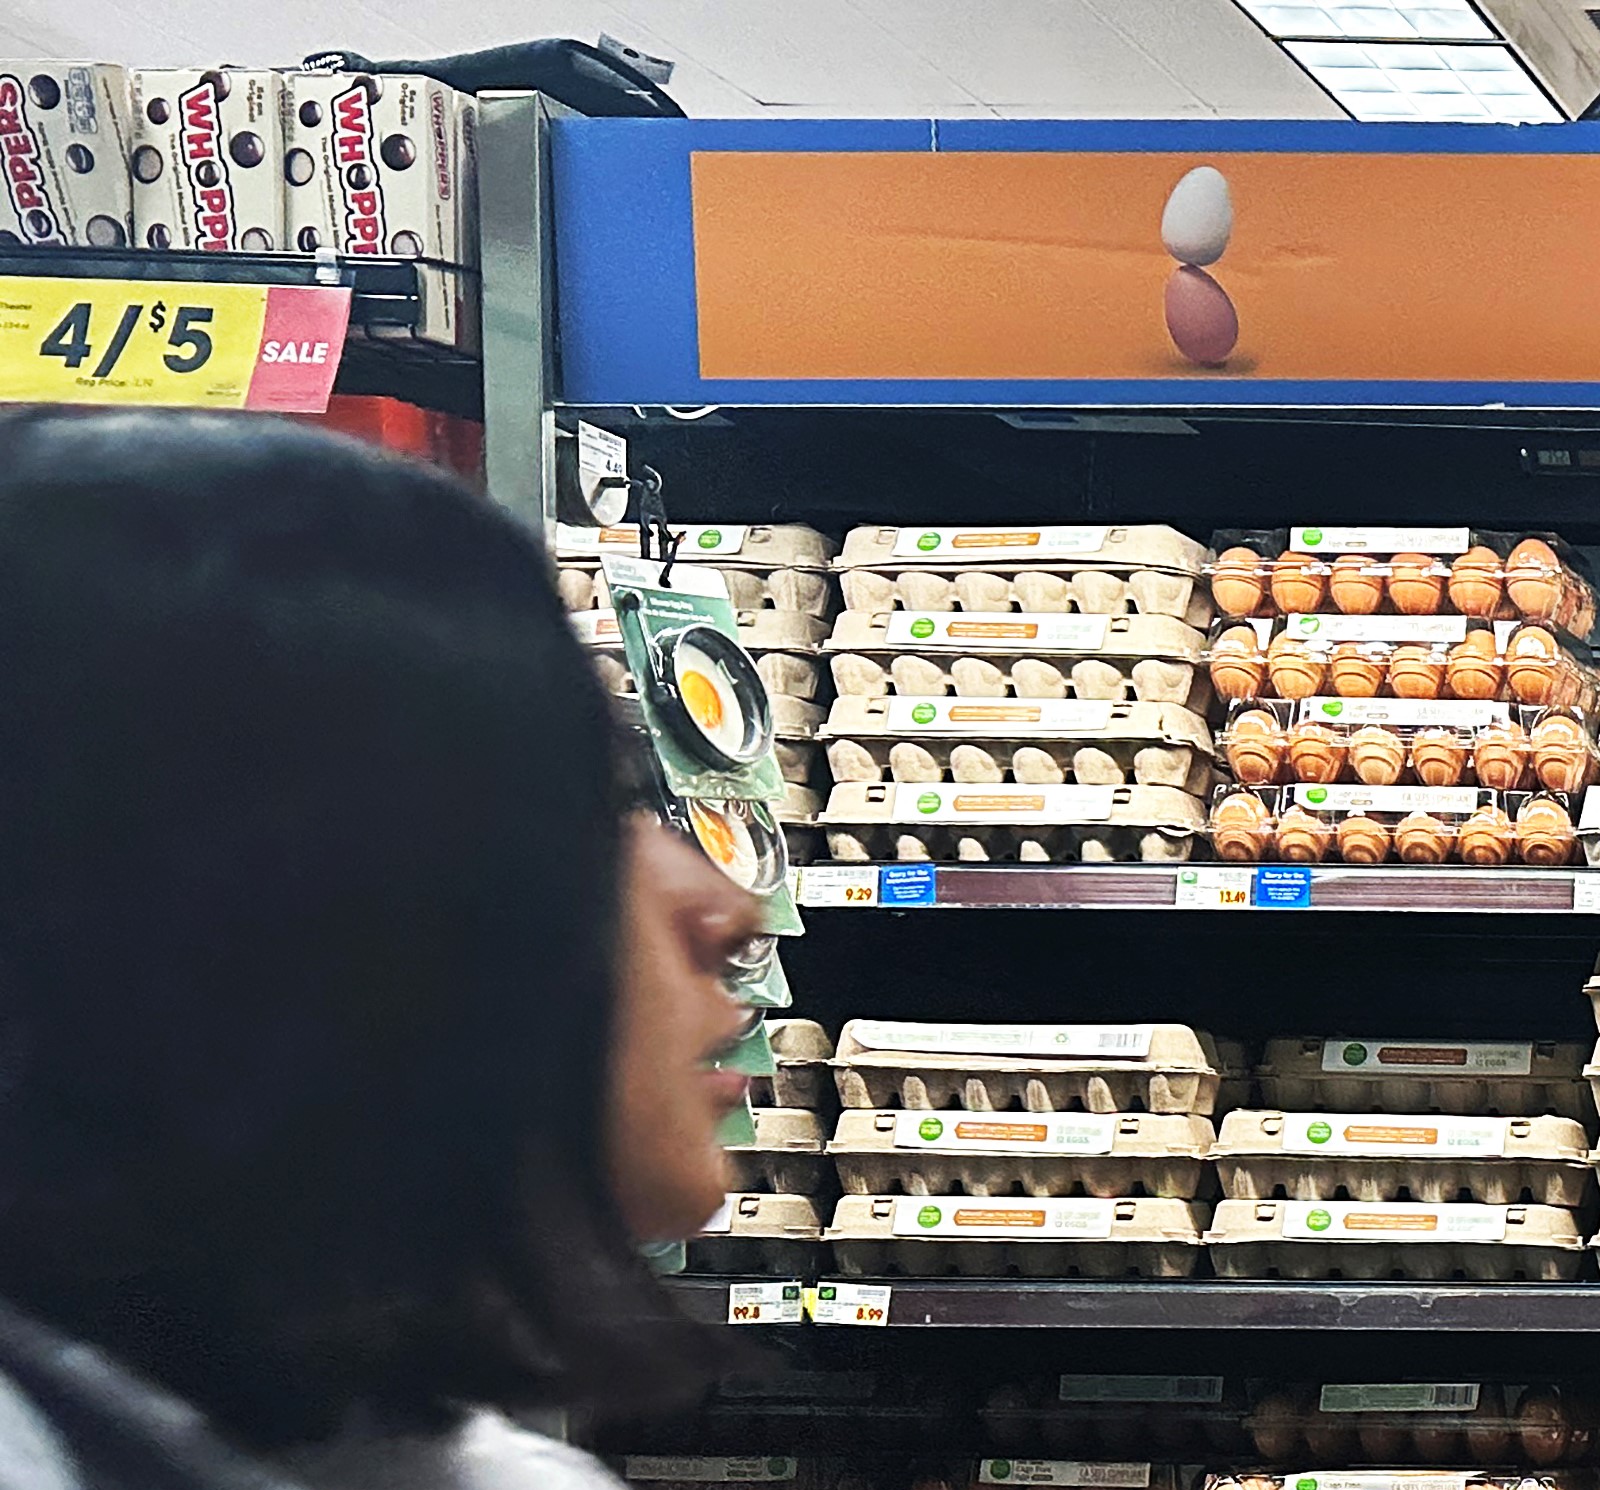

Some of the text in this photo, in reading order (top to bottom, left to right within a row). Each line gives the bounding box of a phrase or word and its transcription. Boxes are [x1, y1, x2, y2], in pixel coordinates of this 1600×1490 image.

[262, 341, 329, 366] SALE
[846, 888, 872, 901] 9.29
[1220, 890, 1245, 904] 13.49
[856, 1308, 883, 1321] 8.99
